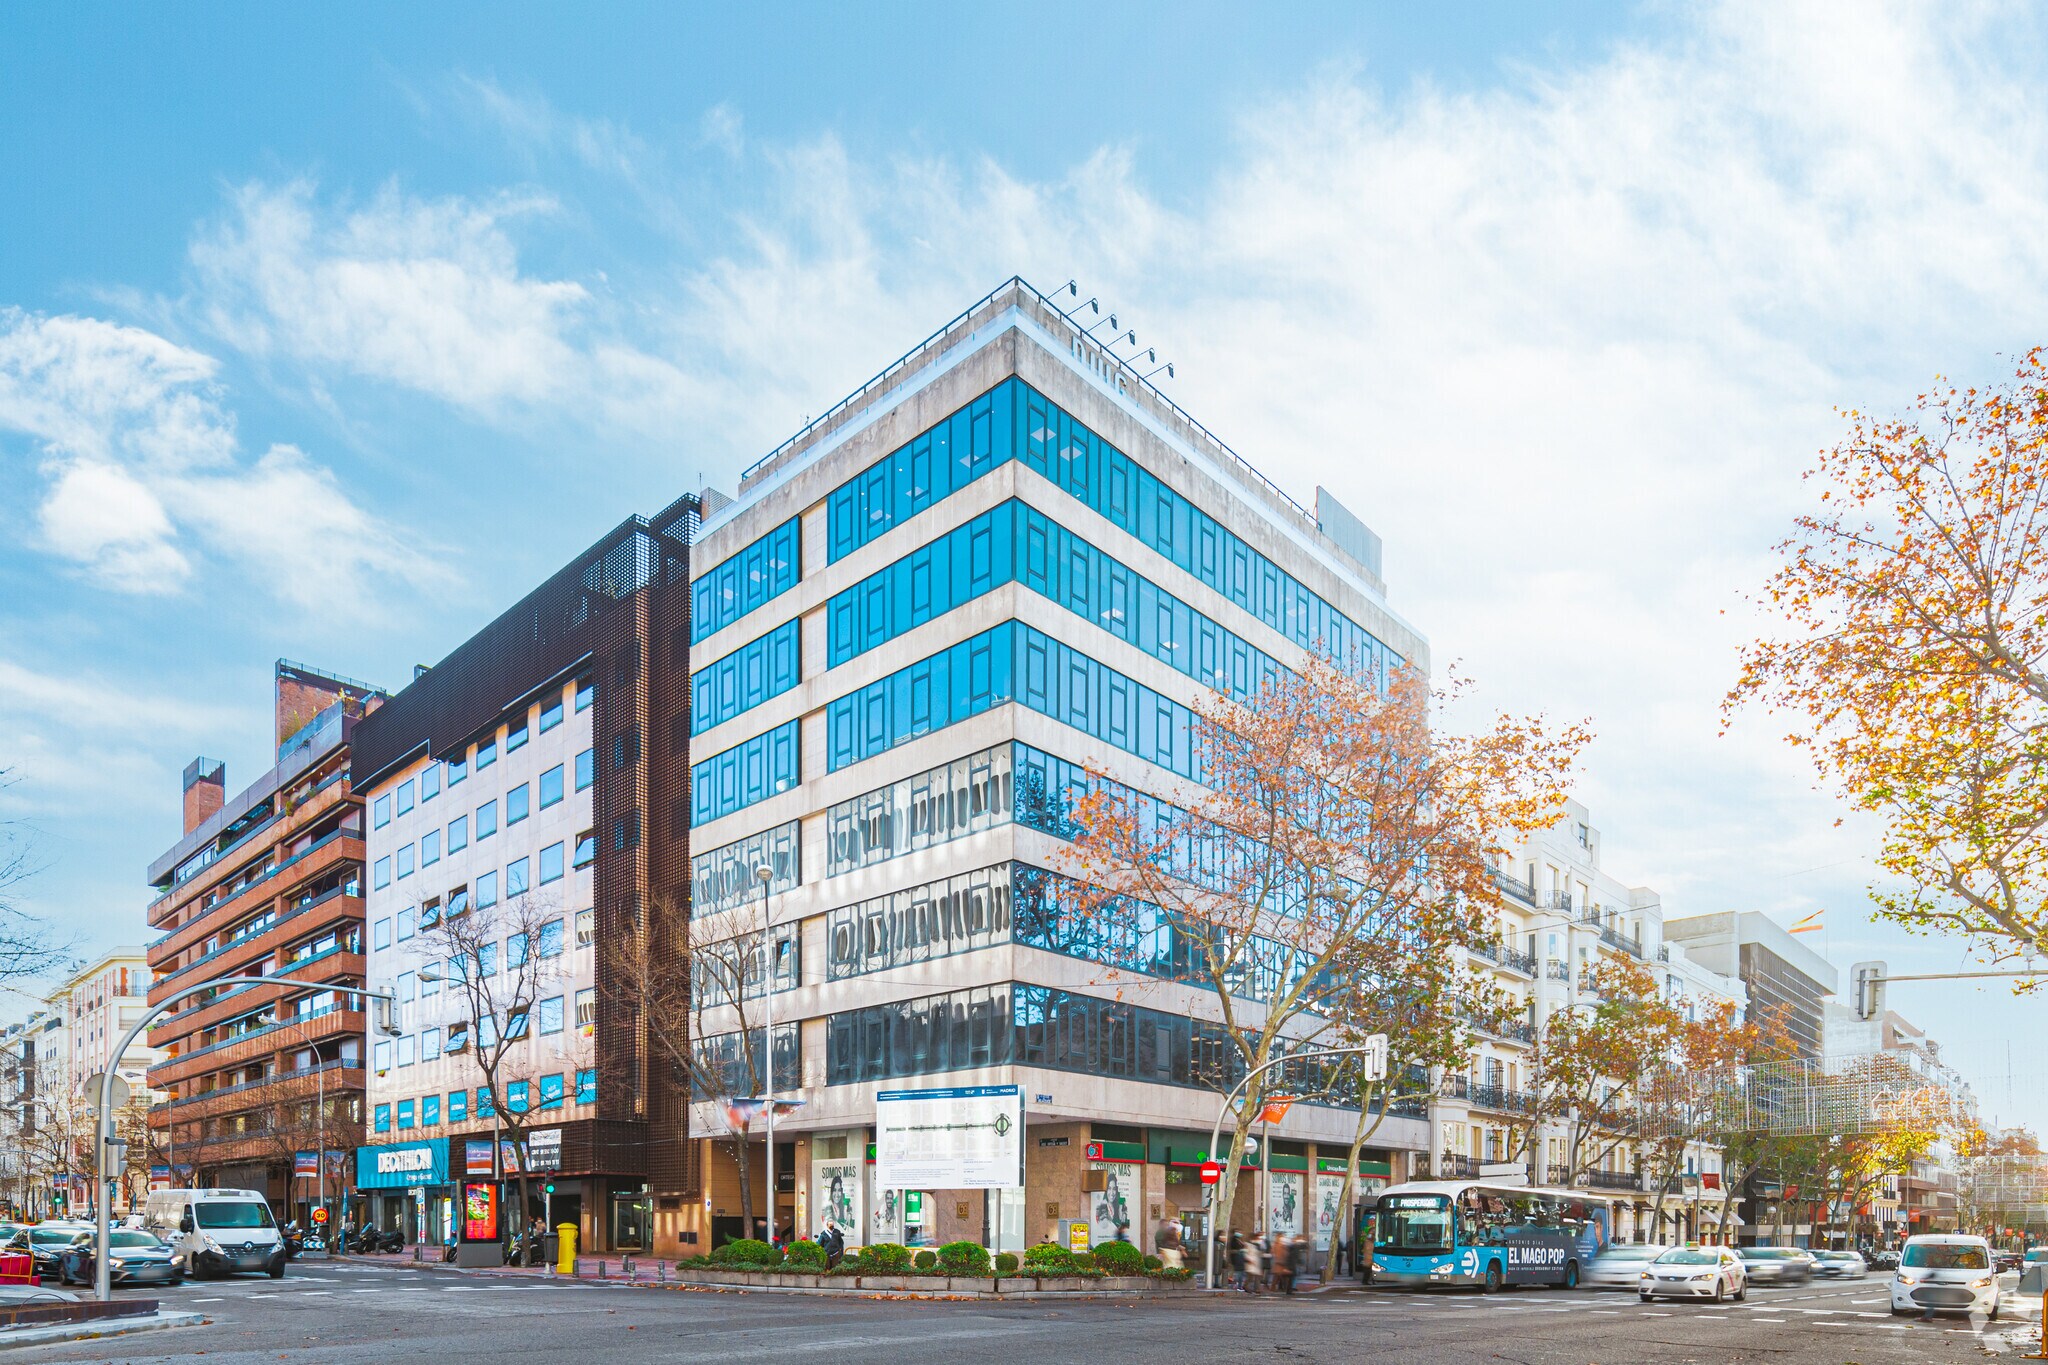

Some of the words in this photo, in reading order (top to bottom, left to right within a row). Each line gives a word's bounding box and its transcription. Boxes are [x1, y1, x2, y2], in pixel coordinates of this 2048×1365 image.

[377, 1148, 433, 1174] DECATHLON
[821, 1166, 842, 1179] SOMOS
[843, 1163, 856, 1178] MÁS
[1389, 1198, 1395, 1208] 1
[1400, 1198, 1437, 1208] PROSPERIDAD
[1508, 1247, 1519, 1264] EL
[1521, 1247, 1547, 1265] MAGO
[1548, 1248, 1565, 1265] POP
